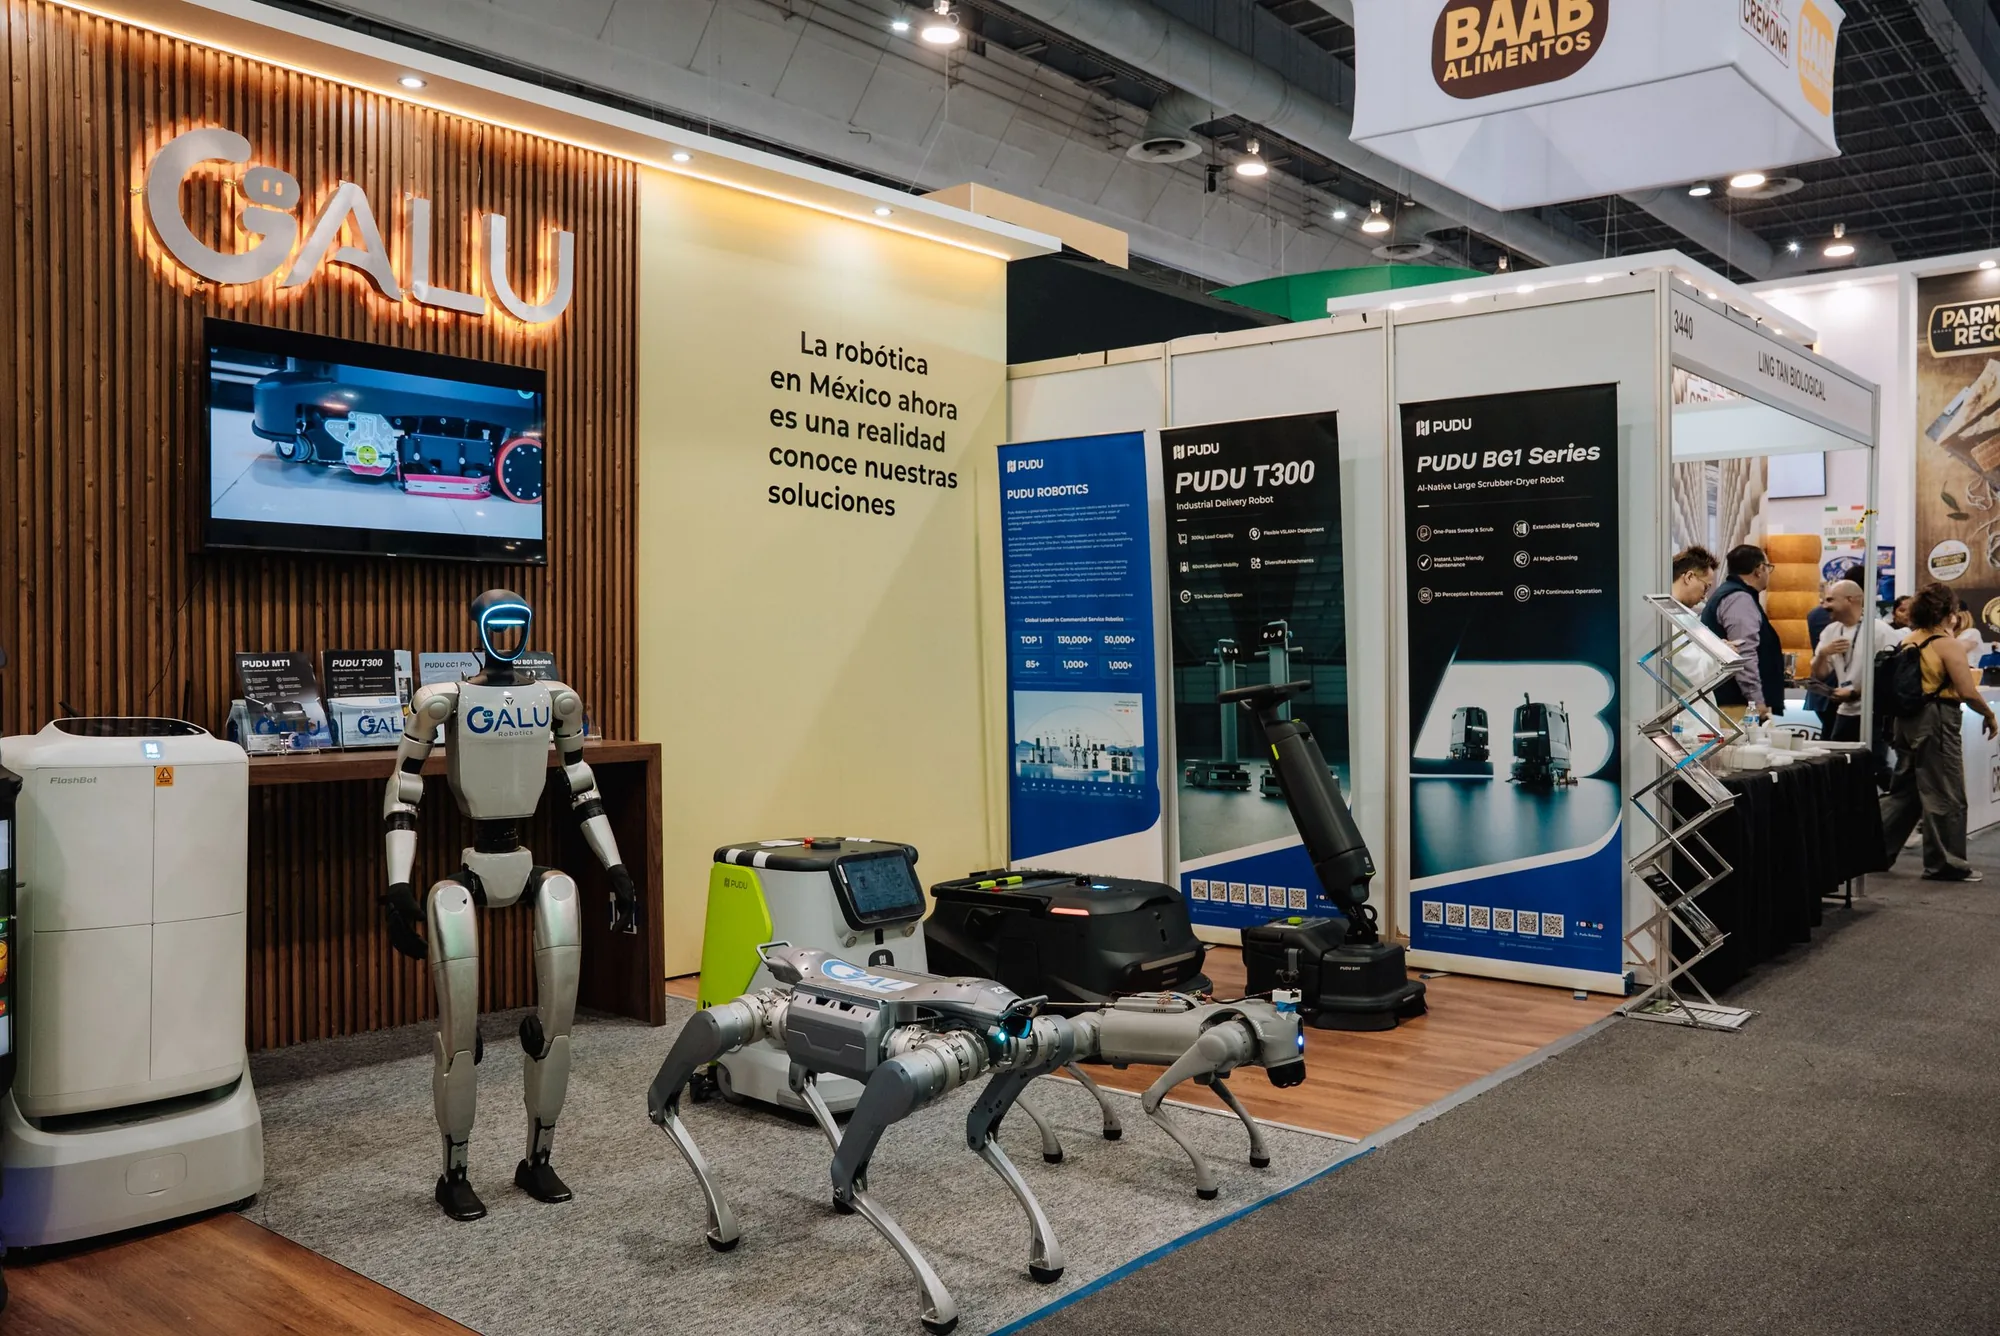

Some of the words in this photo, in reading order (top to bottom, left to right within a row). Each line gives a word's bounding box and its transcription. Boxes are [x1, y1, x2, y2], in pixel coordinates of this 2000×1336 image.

[1445, 0, 1595, 61] BAAB
[1743, 0, 1788, 58] CREMONA
[1443, 31, 1591, 82] ALIMENTOS
[145, 127, 574, 324] GALU
[1674, 309, 1694, 340] 3440
[801, 331, 827, 357] La
[836, 341, 928, 376] robótica
[1758, 351, 1774, 378] LING
[1776, 359, 1789, 384] TAN
[1790, 366, 1826, 401] BIOLOGICAL
[770, 370, 801, 392] en
[810, 372, 891, 408] México
[899, 390, 958, 420] ahora
[770, 408, 797, 429] es
[805, 413, 849, 438] una
[858, 422, 945, 453] realidad
[1433, 418, 1472, 433] PUDU
[1187, 442, 1220, 457] PUDU
[1416, 452, 1477, 473] PUDU
[1482, 448, 1522, 469] BG1
[1528, 442, 1601, 465] Series
[769, 446, 857, 476] conoce
[865, 459, 958, 489] nuestras
[1018, 458, 1044, 471] PUDU
[1175, 466, 1247, 494] PUDU
[1253, 459, 1316, 487] T300
[1007, 488, 1034, 500] PUDU
[1037, 484, 1089, 498] ROBOTICS
[1417, 482, 1452, 492] AI-Native
[1454, 480, 1476, 491] Large
[1478, 476, 1538, 488] Scrubber-Dryer
[1540, 475, 1565, 484] Robot
[768, 482, 896, 517] soluciones
[1176, 499, 1214, 510] Industrial
[1214, 496, 1248, 508] Delivery
[1248, 495, 1274, 504] Robot
[1020, 636, 1038, 644] TOP
[242, 659, 270, 668] PUDU
[272, 659, 290, 667] MT1
[332, 659, 360, 668] PUDU
[361, 658, 383, 667] T300
[424, 661, 445, 669] PUDU
[1025, 660, 1040, 669] 85+
[467, 706, 550, 734] GALU
[50, 776, 98, 785] FlashBot
